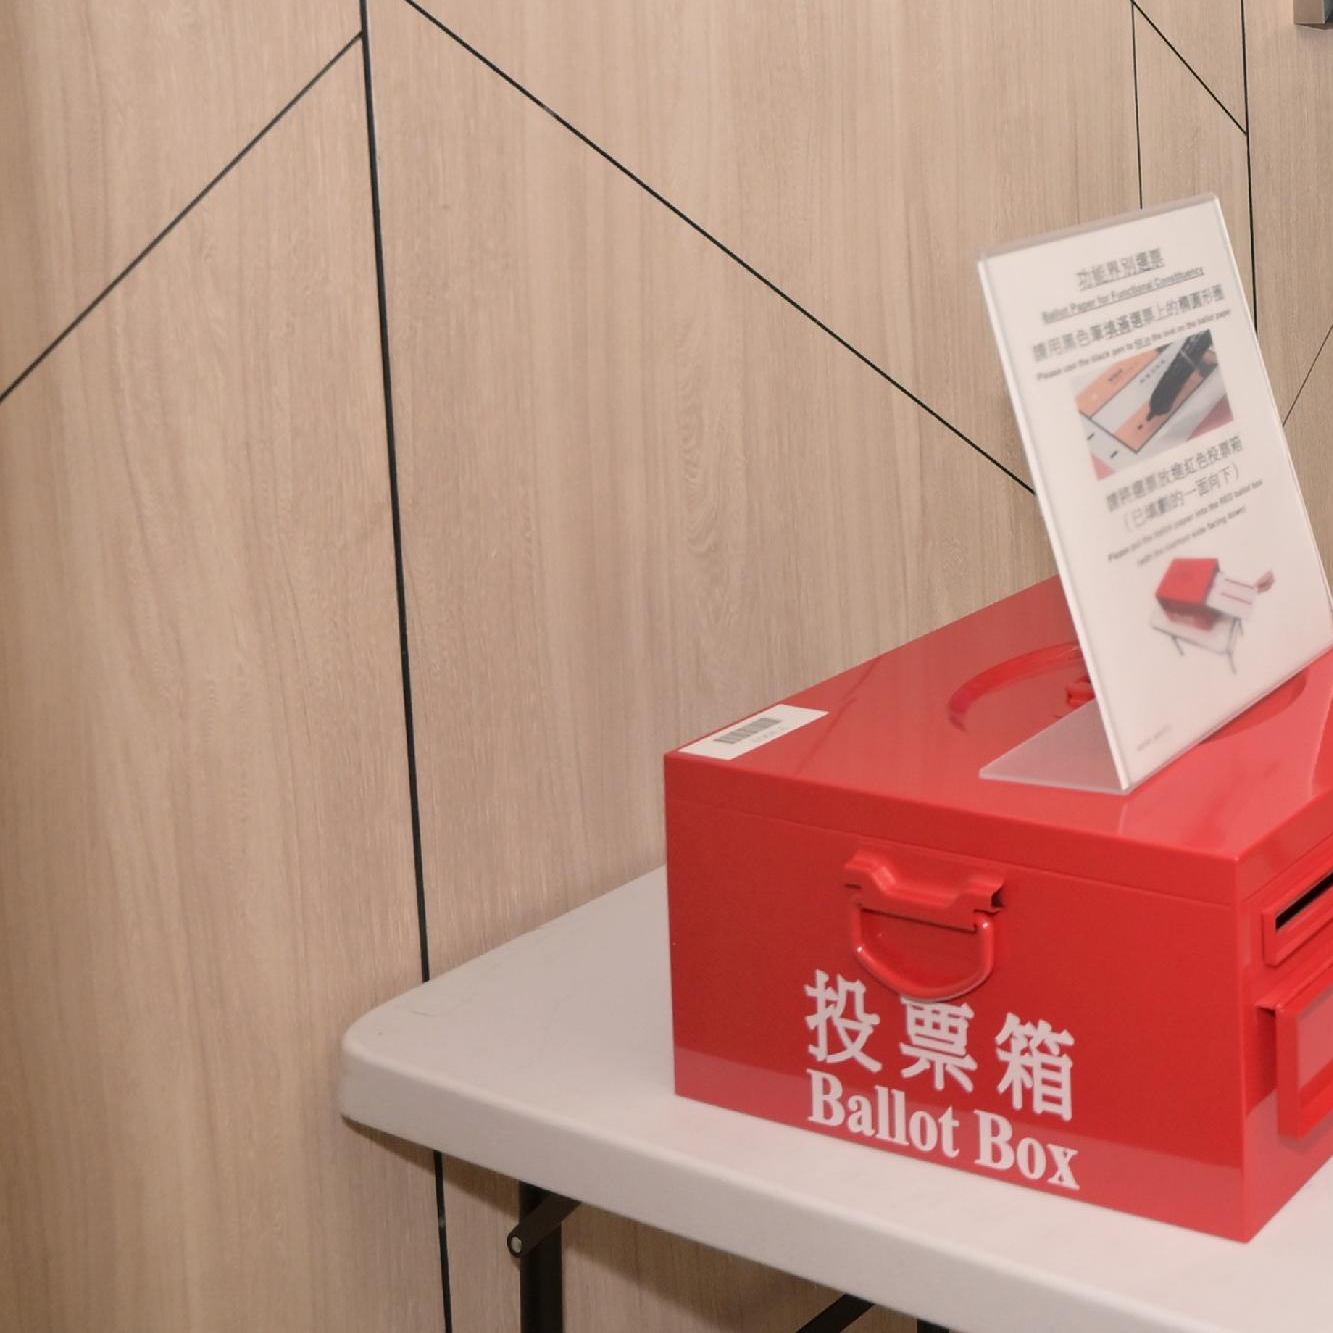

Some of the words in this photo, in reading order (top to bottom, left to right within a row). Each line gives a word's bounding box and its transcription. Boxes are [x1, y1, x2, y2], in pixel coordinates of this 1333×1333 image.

[1069, 298, 1097, 318] Paper
[1111, 283, 1152, 306] Functional
[1152, 266, 1205, 294] Constituency
[804, 969, 1075, 1122] 投票箱
[806, 1068, 960, 1158] Ballot
[974, 1108, 1080, 1190] Box
